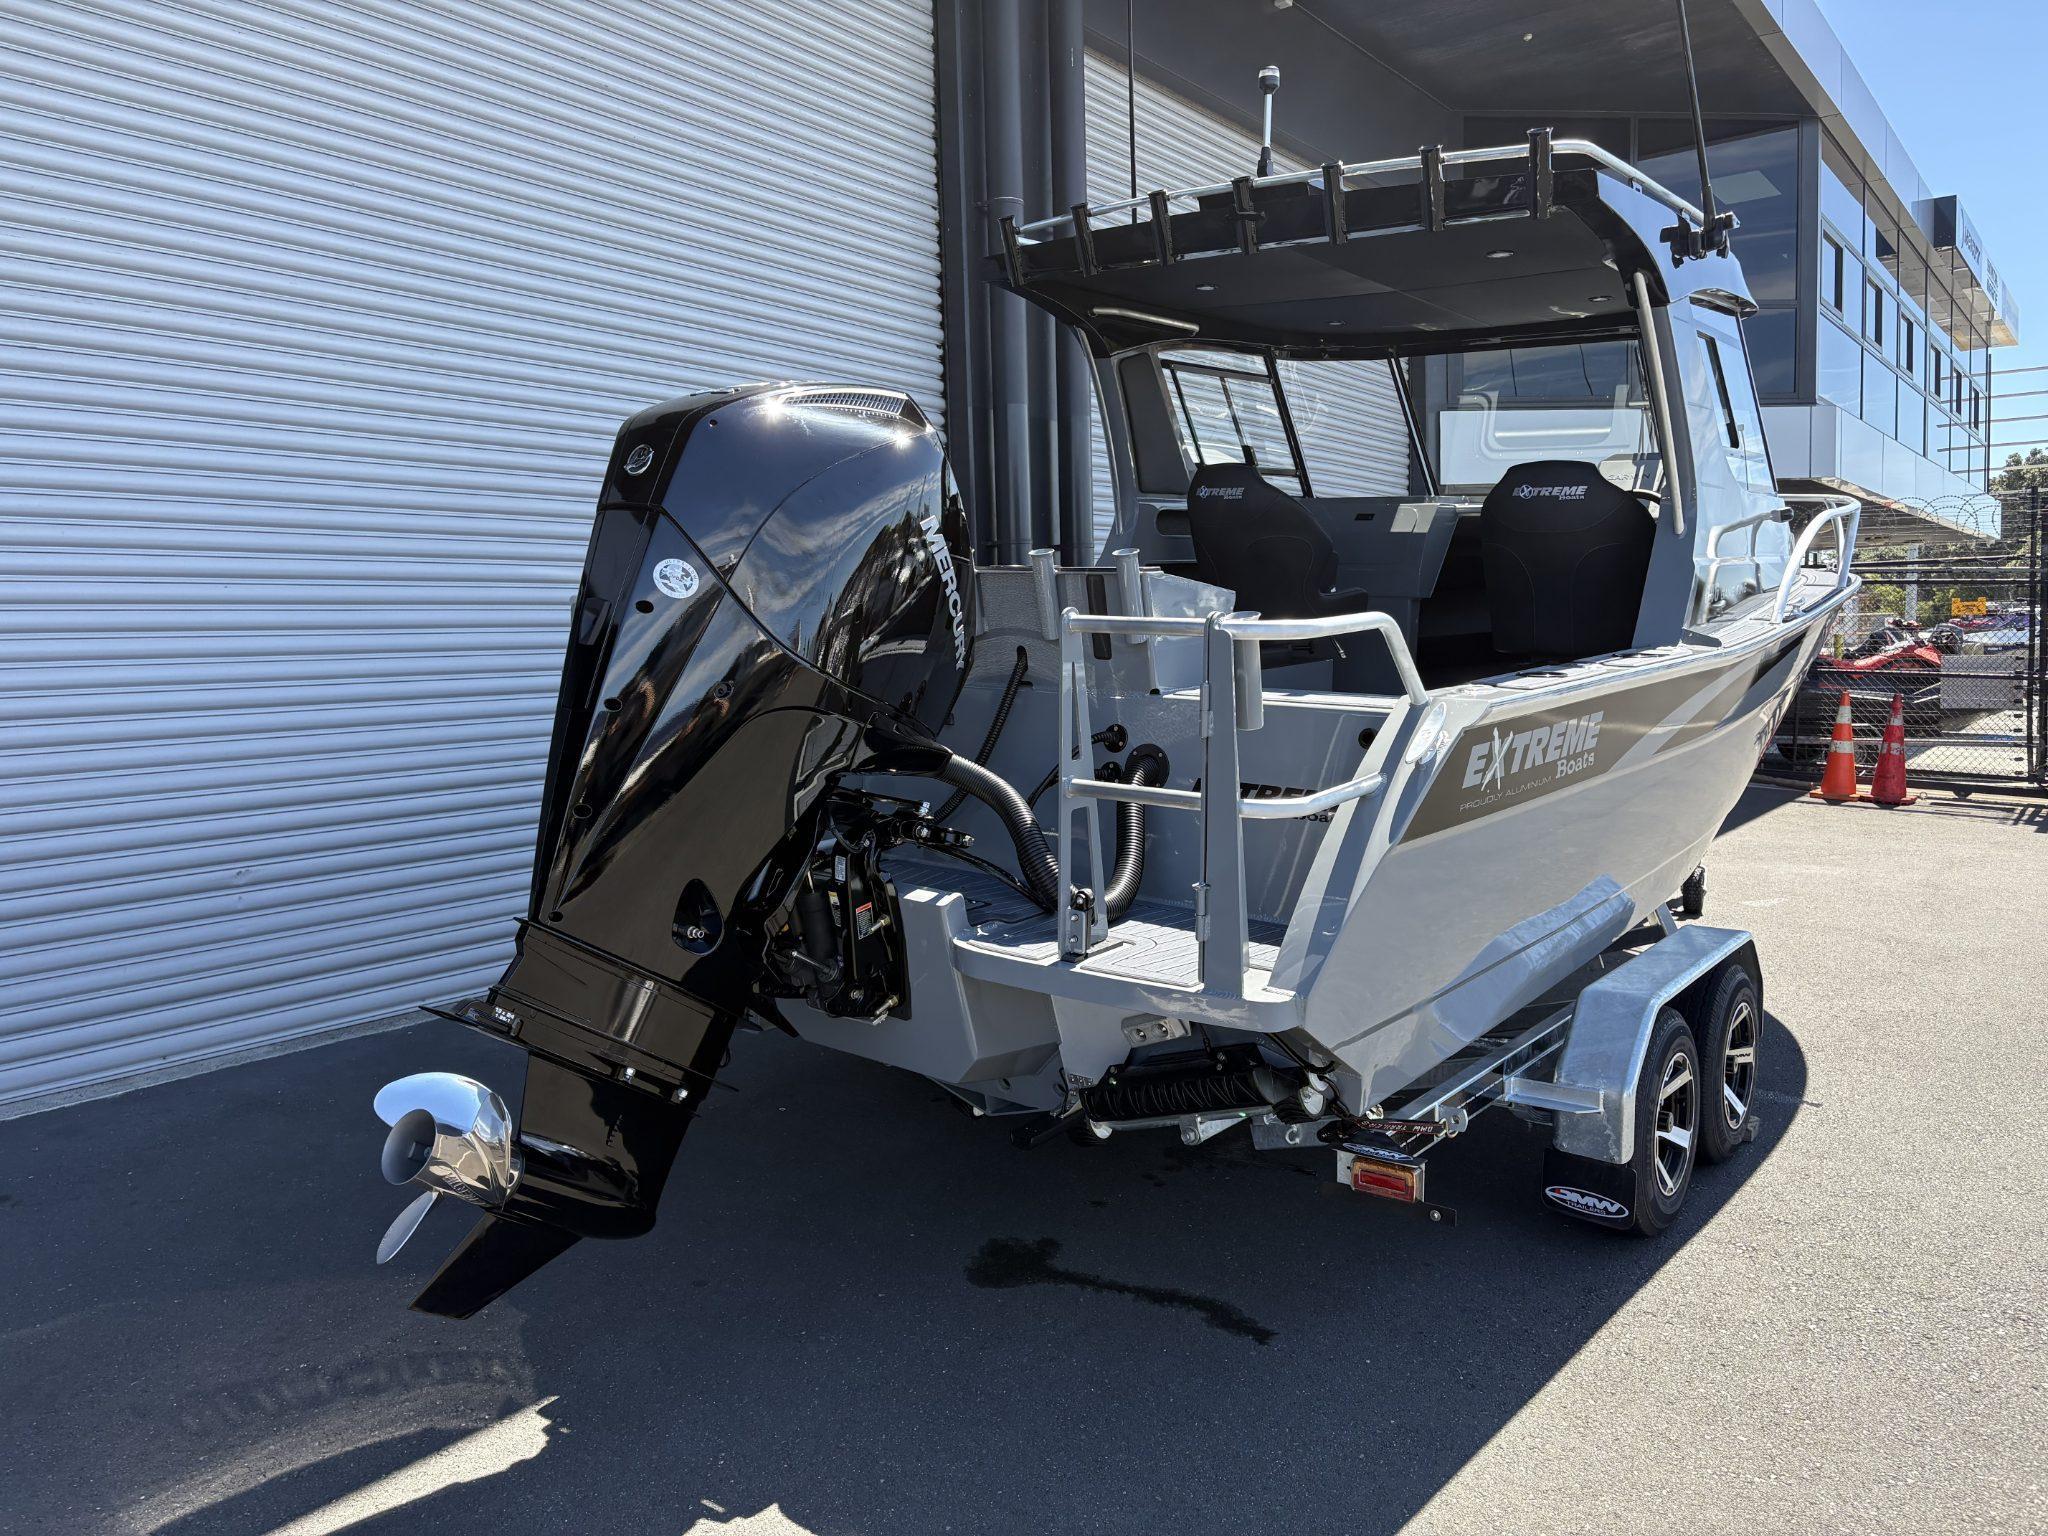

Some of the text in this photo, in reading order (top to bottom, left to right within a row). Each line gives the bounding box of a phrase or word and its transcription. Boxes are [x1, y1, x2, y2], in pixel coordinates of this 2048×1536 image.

[1512, 484, 1588, 499] EXTREME
[919, 514, 966, 671] MERCURY
[1462, 710, 1604, 791] EXTREME
[1555, 751, 1595, 779] Boats
[1459, 791, 1503, 812] PROUDLY
[1549, 1188, 1620, 1213] DMW
[1567, 1200, 1606, 1215] TRAILERS
